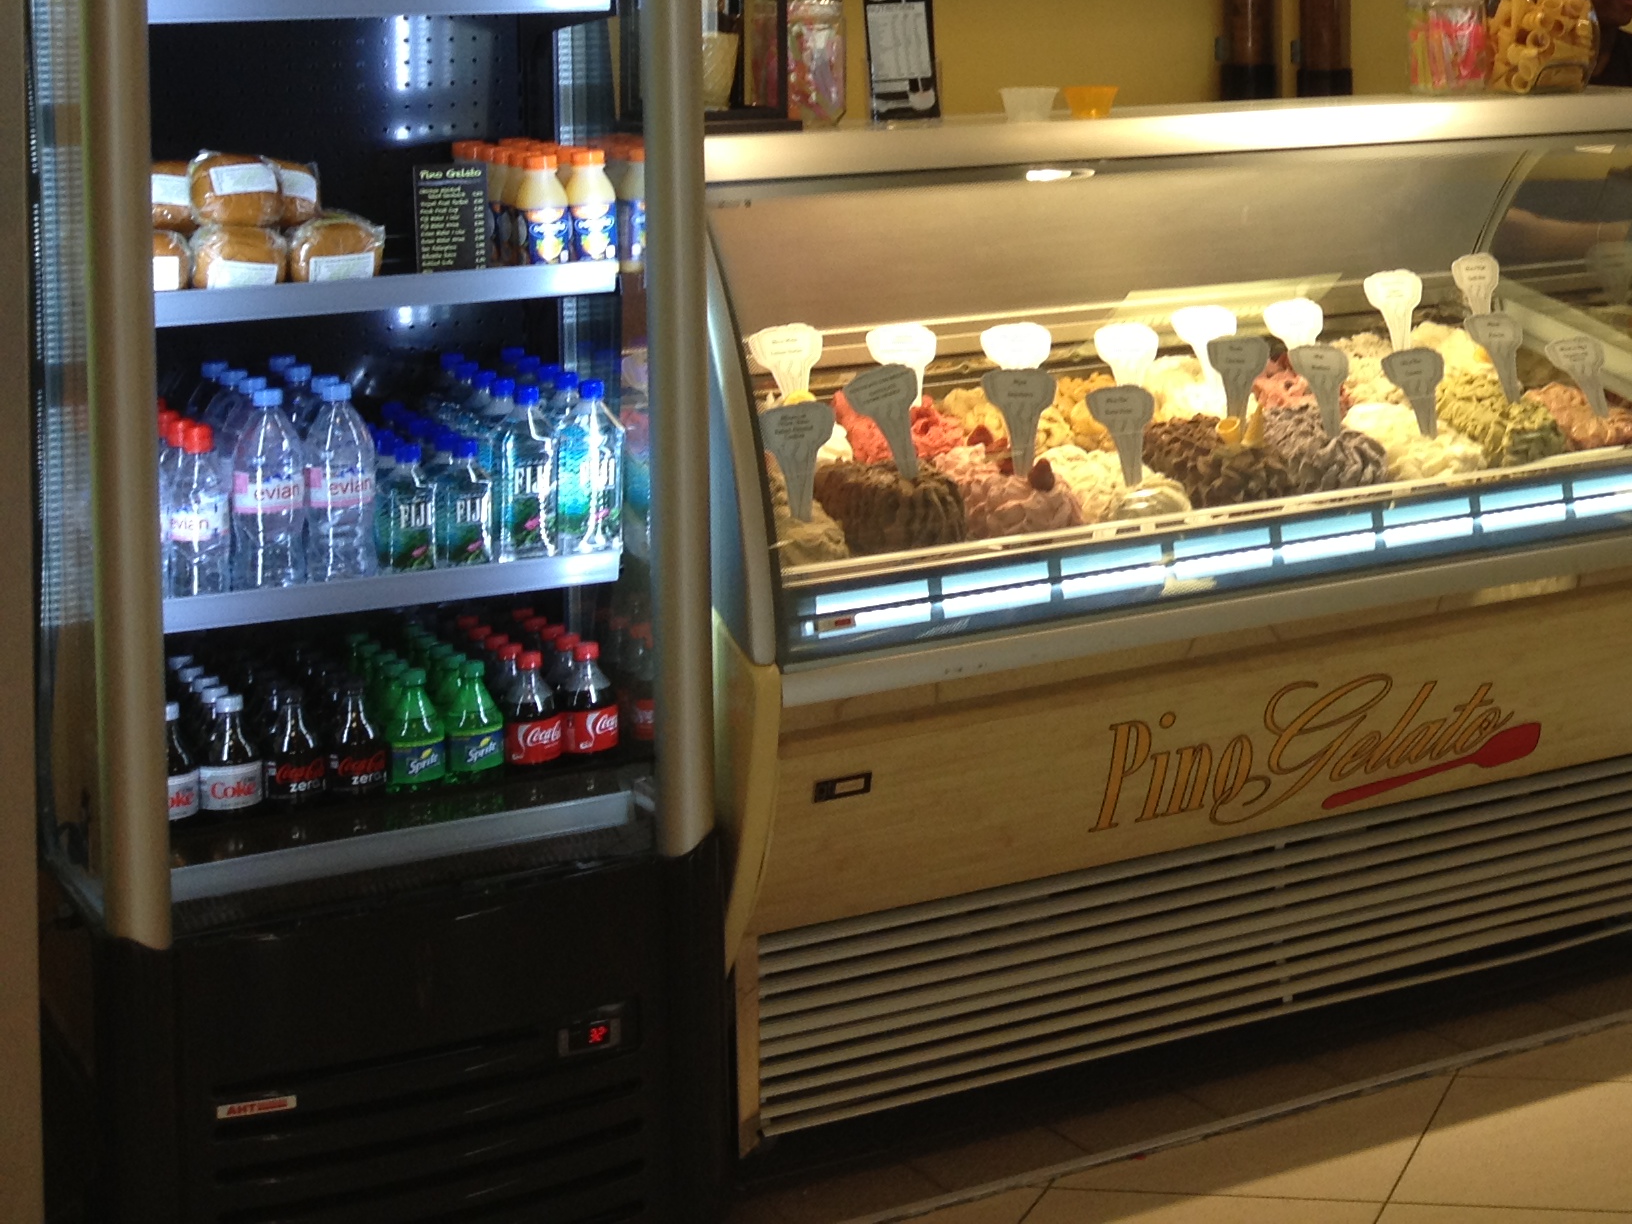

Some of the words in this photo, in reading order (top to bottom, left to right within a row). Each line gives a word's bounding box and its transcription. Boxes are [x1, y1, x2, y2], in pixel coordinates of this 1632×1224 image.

[253, 483, 299, 502] evian
[329, 477, 372, 496] evian
[401, 499, 434, 528] FIJI
[466, 743, 497, 764] Sprite
[408, 753, 439, 775] Sprite
[290, 778, 320, 793] zero
[352, 772, 382, 786] zero
[211, 780, 256, 800] Coke
[168, 791, 194, 810] oke
